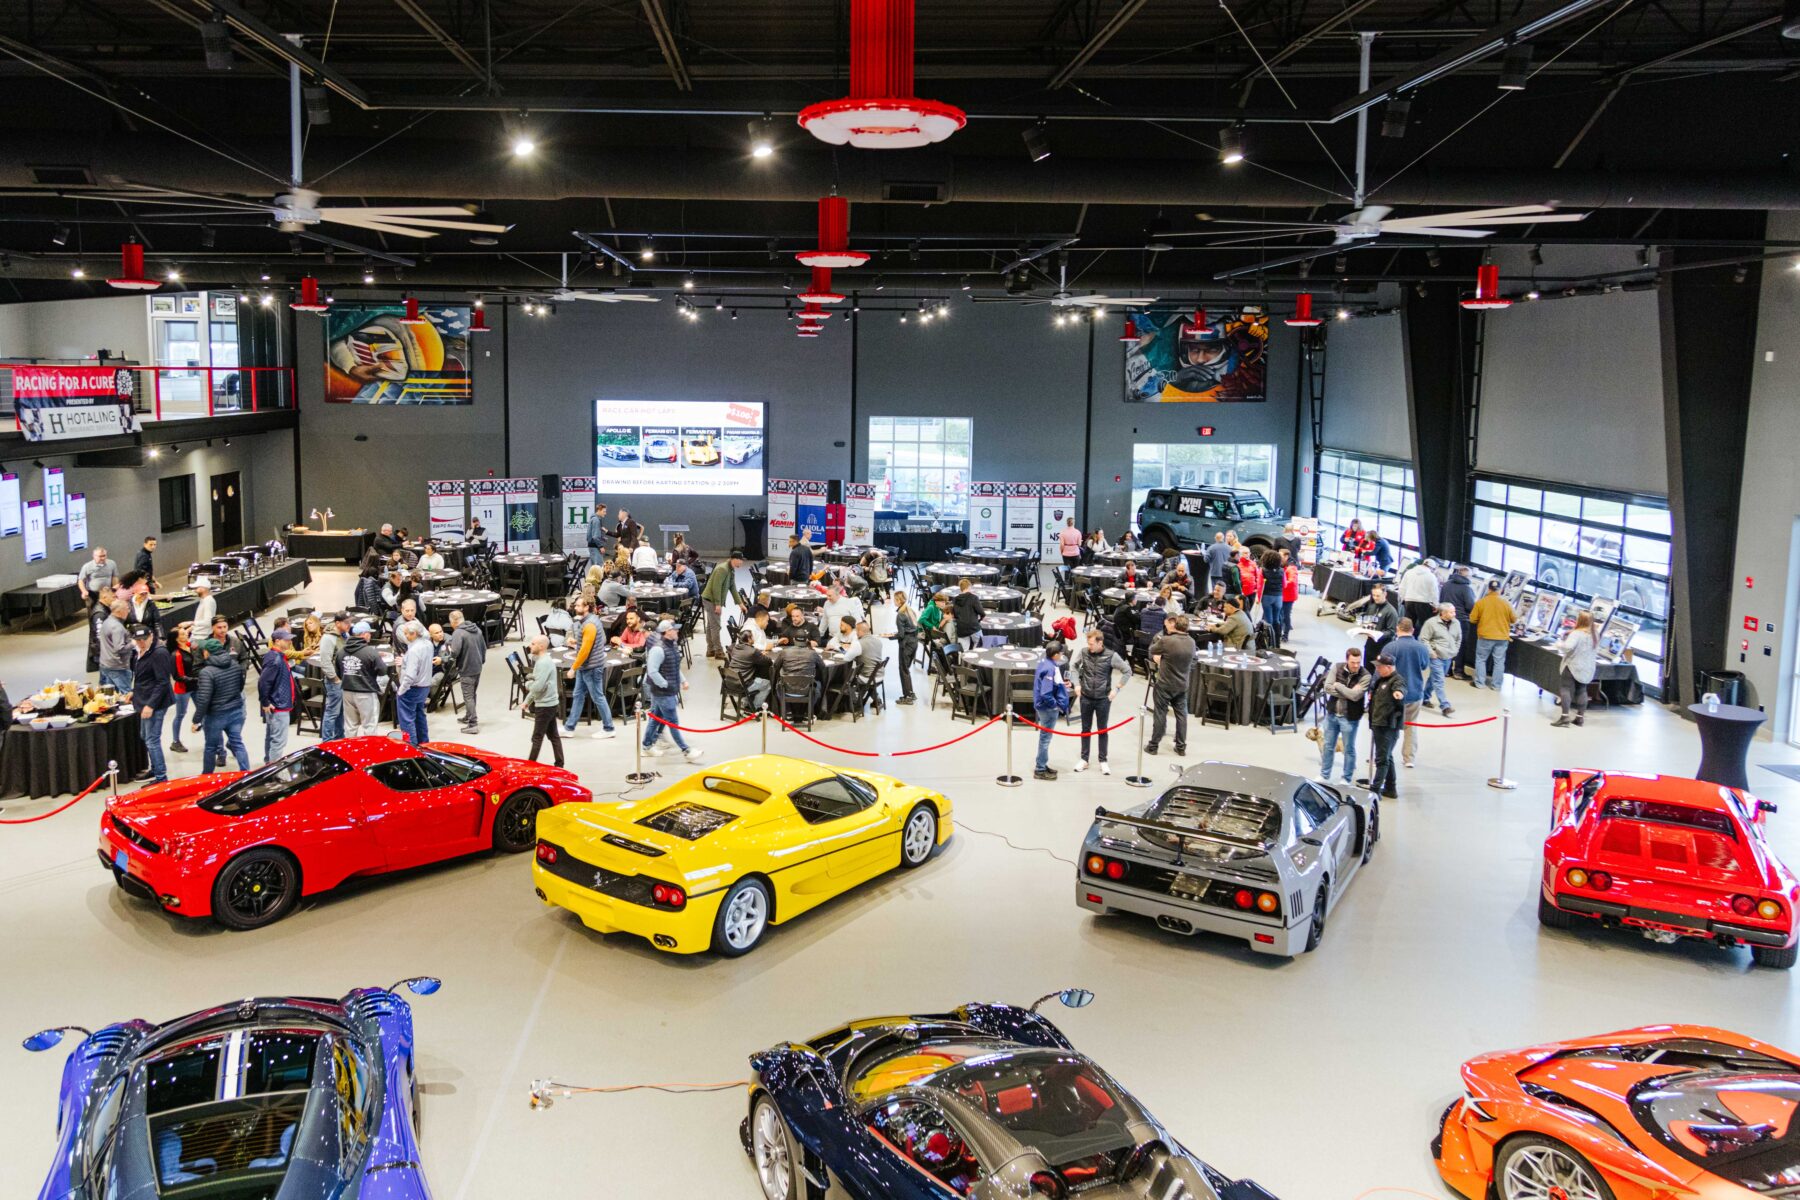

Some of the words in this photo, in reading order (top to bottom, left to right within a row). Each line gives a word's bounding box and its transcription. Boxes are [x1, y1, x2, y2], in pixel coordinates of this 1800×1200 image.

[15, 375, 56, 391] RACING
[59, 375, 81, 390] FOR
[81, 376, 88, 390] A
[89, 375, 115, 389] CURE
[66, 398, 88, 406] PRESENTED
[49, 413, 66, 434] H
[66, 411, 116, 425] HOTALING
[48, 484, 62, 506] H
[483, 509, 492, 519] 11
[567, 506, 590, 525] H
[31, 519, 39, 531] 11
[800, 524, 825, 532] CAIOLA
